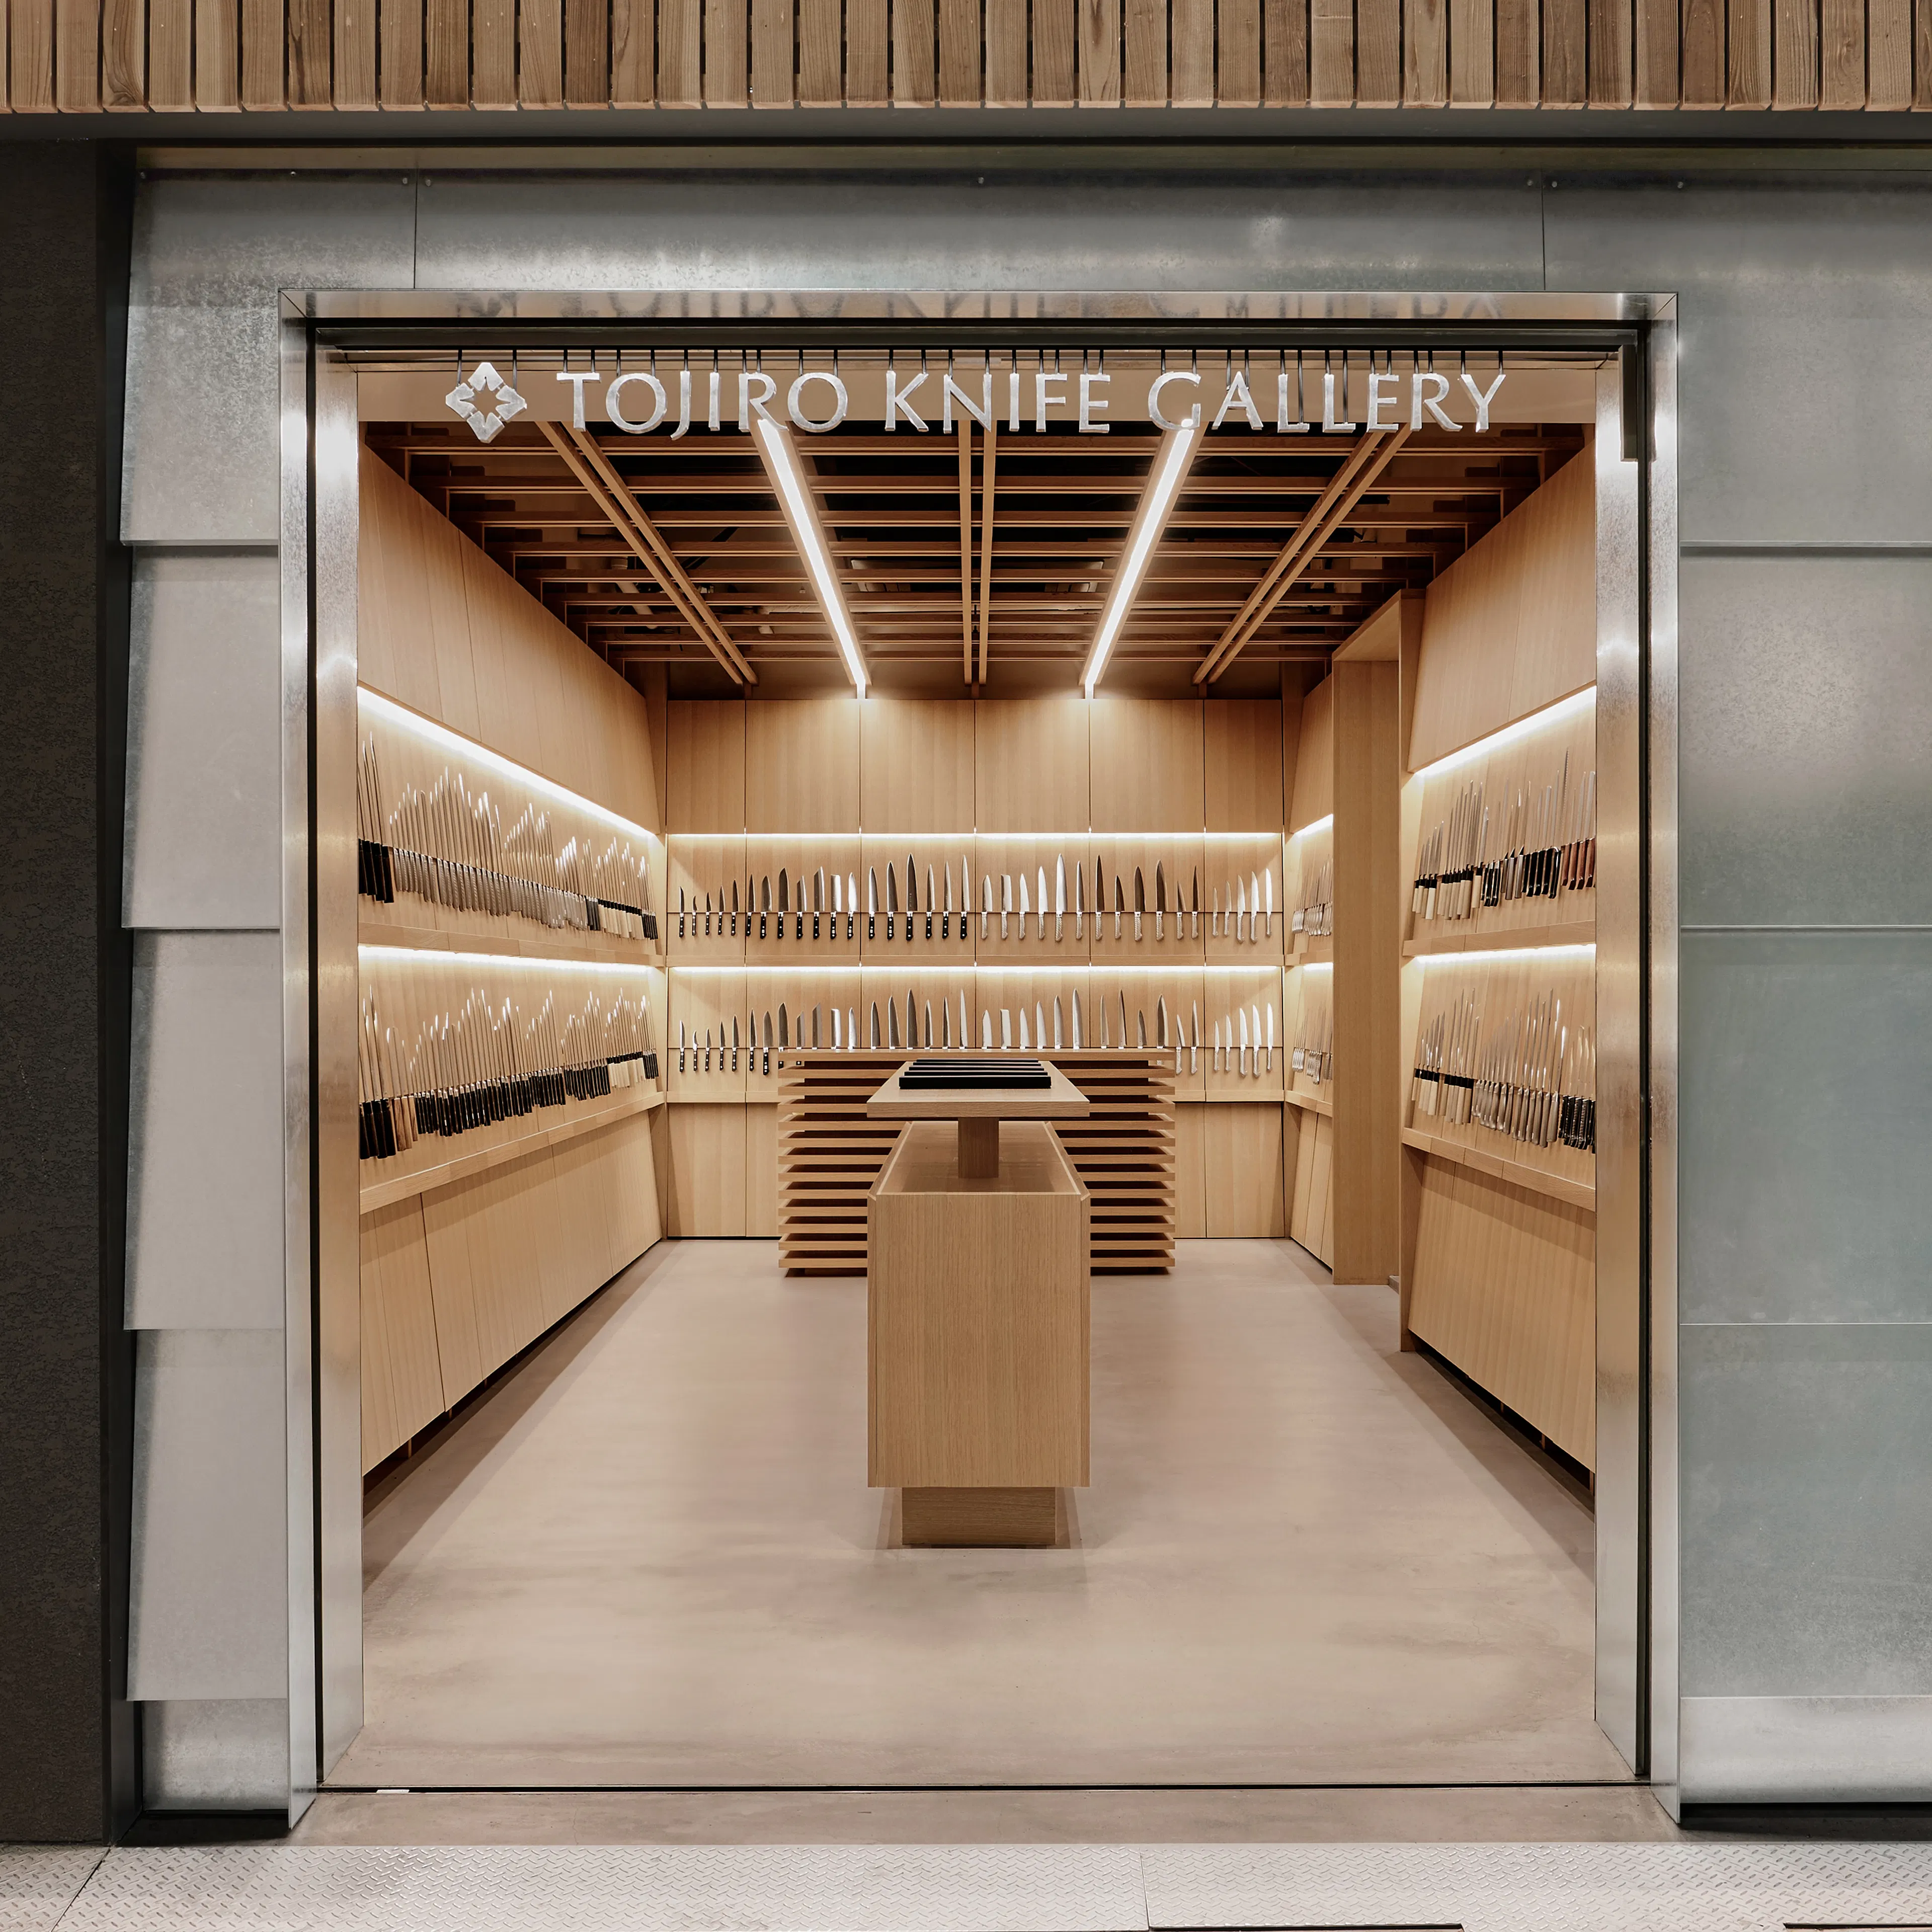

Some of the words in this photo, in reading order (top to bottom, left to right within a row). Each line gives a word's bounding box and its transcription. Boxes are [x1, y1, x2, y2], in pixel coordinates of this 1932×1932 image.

[556, 371, 848, 440] TOJIRO
[885, 371, 1110, 433] KNIFE
[1148, 371, 1506, 433] GALLERY
